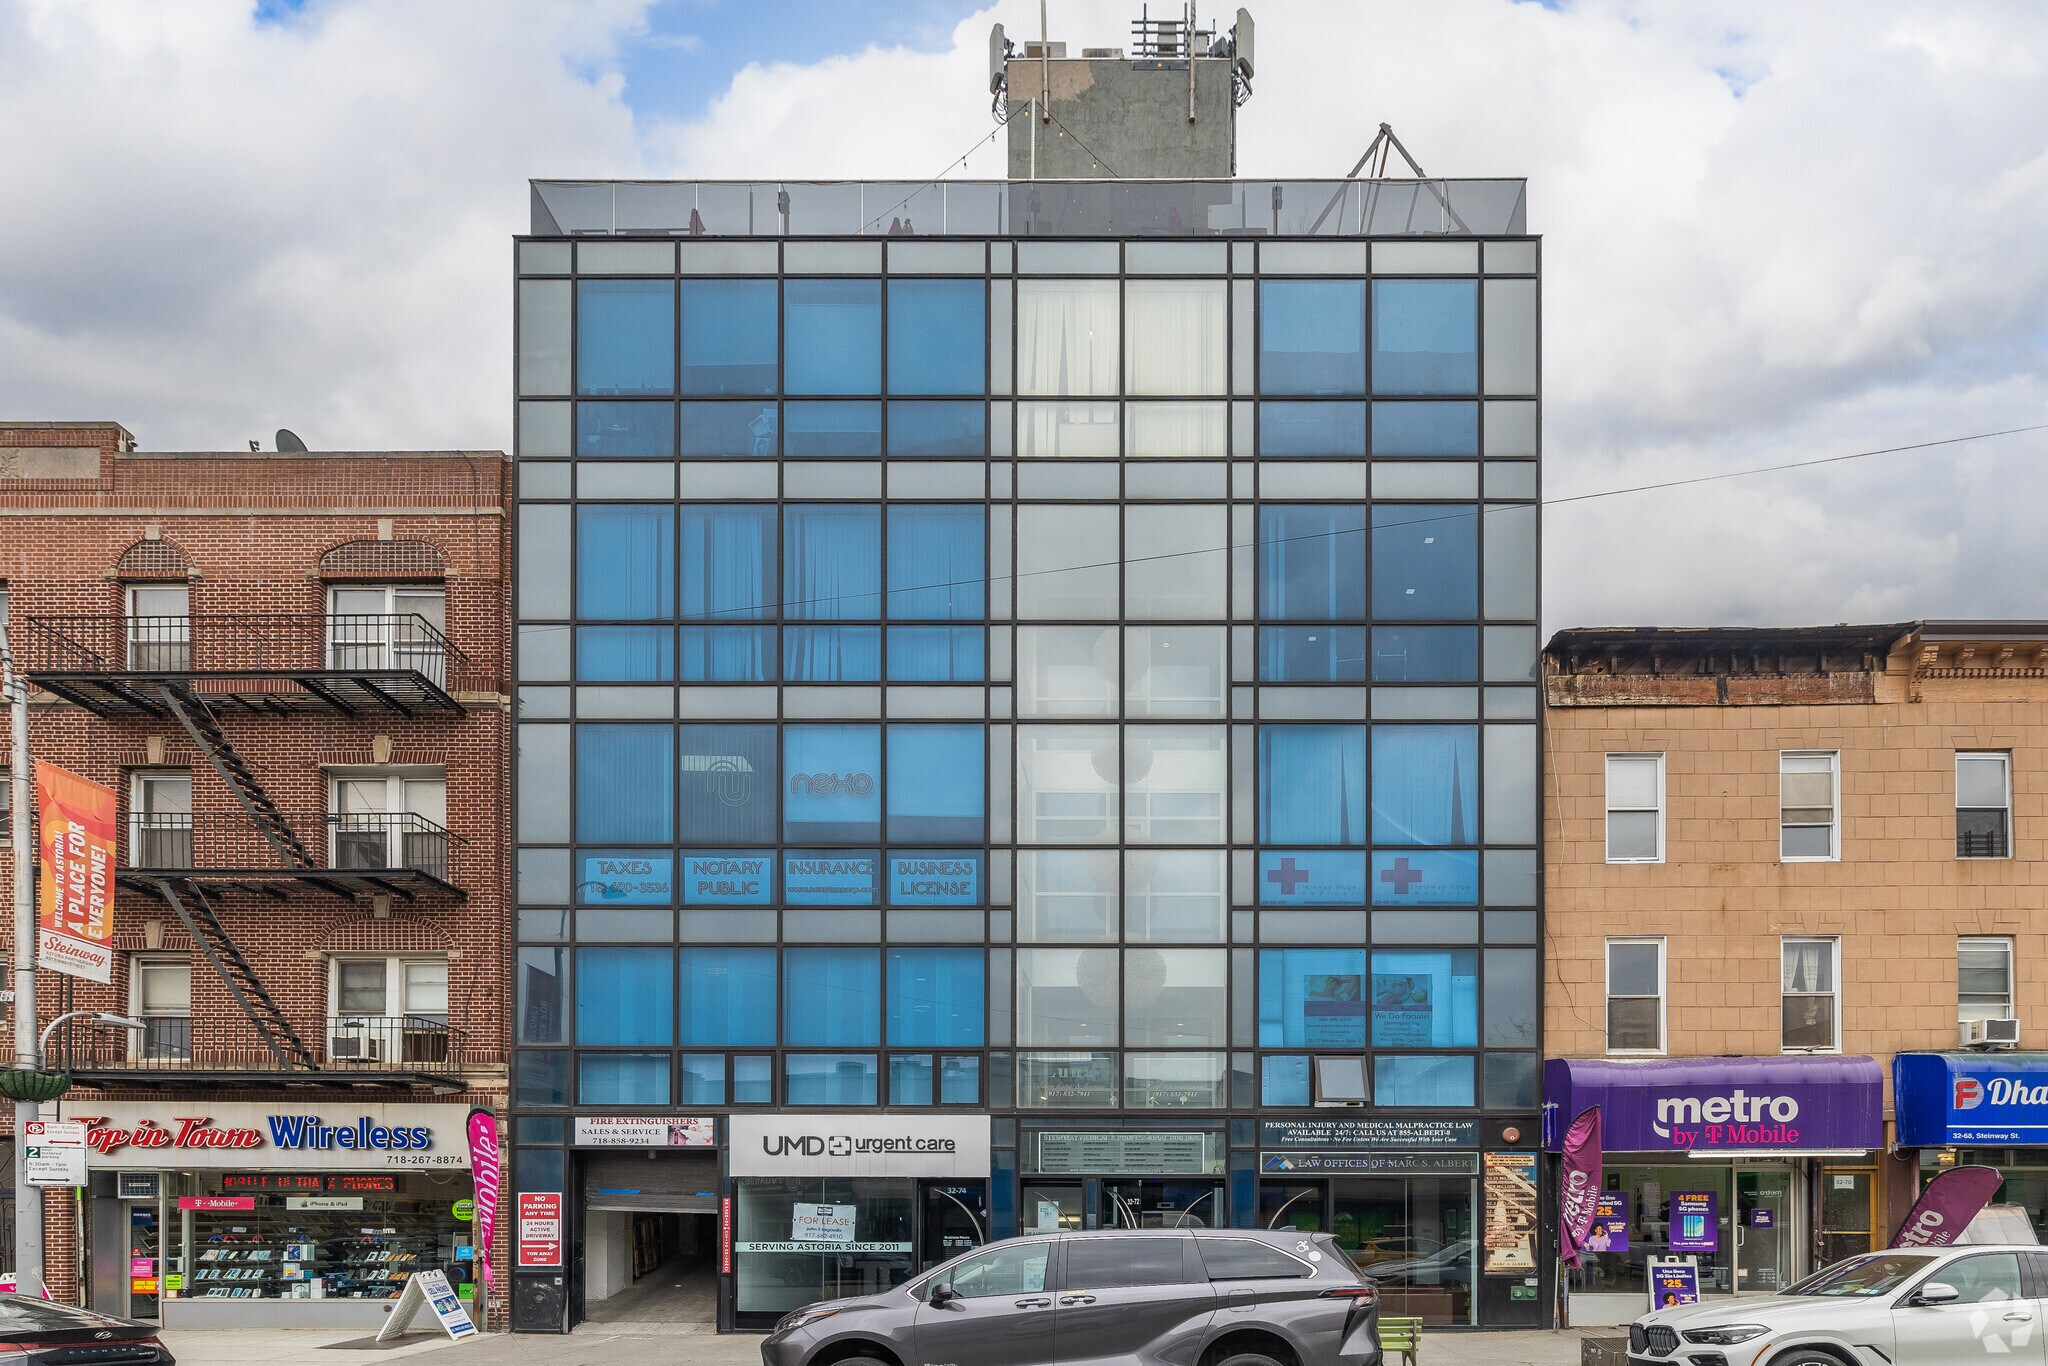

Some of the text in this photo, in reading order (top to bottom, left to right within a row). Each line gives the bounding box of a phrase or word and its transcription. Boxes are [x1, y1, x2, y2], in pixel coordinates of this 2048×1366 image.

[791, 773, 873, 795] nexo
[597, 861, 652, 875] TAXES
[694, 861, 763, 875] NOTARY
[788, 861, 875, 875] INSURANCE
[898, 861, 973, 875] BUSINESS
[55, 830, 64, 928] WELCOME TO ASTORIA!
[67, 821, 86, 934] A PLACE FOR
[88, 845, 106, 939] EVERYONE!
[697, 881, 759, 894] PUBLIC
[900, 881, 970, 895] LICENSE
[44, 936, 107, 967] Steinway
[1653, 1090, 1799, 1130] metro
[130, 1119, 170, 1147] in
[173, 1117, 262, 1147] Town
[267, 1115, 430, 1150] Wireless
[1673, 1126, 1699, 1150] by
[1726, 1124, 1799, 1143] Mobile
[28, 1147, 38, 1157] 2
[763, 1136, 956, 1156] UMD urgent care
[386, 1155, 463, 1164] 718-267-8874
[1298, 1160, 1474, 1168] LAW OFFICES OF MARC S. ALBERT
[1585, 1185, 1598, 1216] Mobile
[798, 1216, 850, 1226] FOR LEASE
[749, 1243, 900, 1251] SERVING ASTORIA SINCE 2011
[1663, 1279, 1682, 1288] $25
